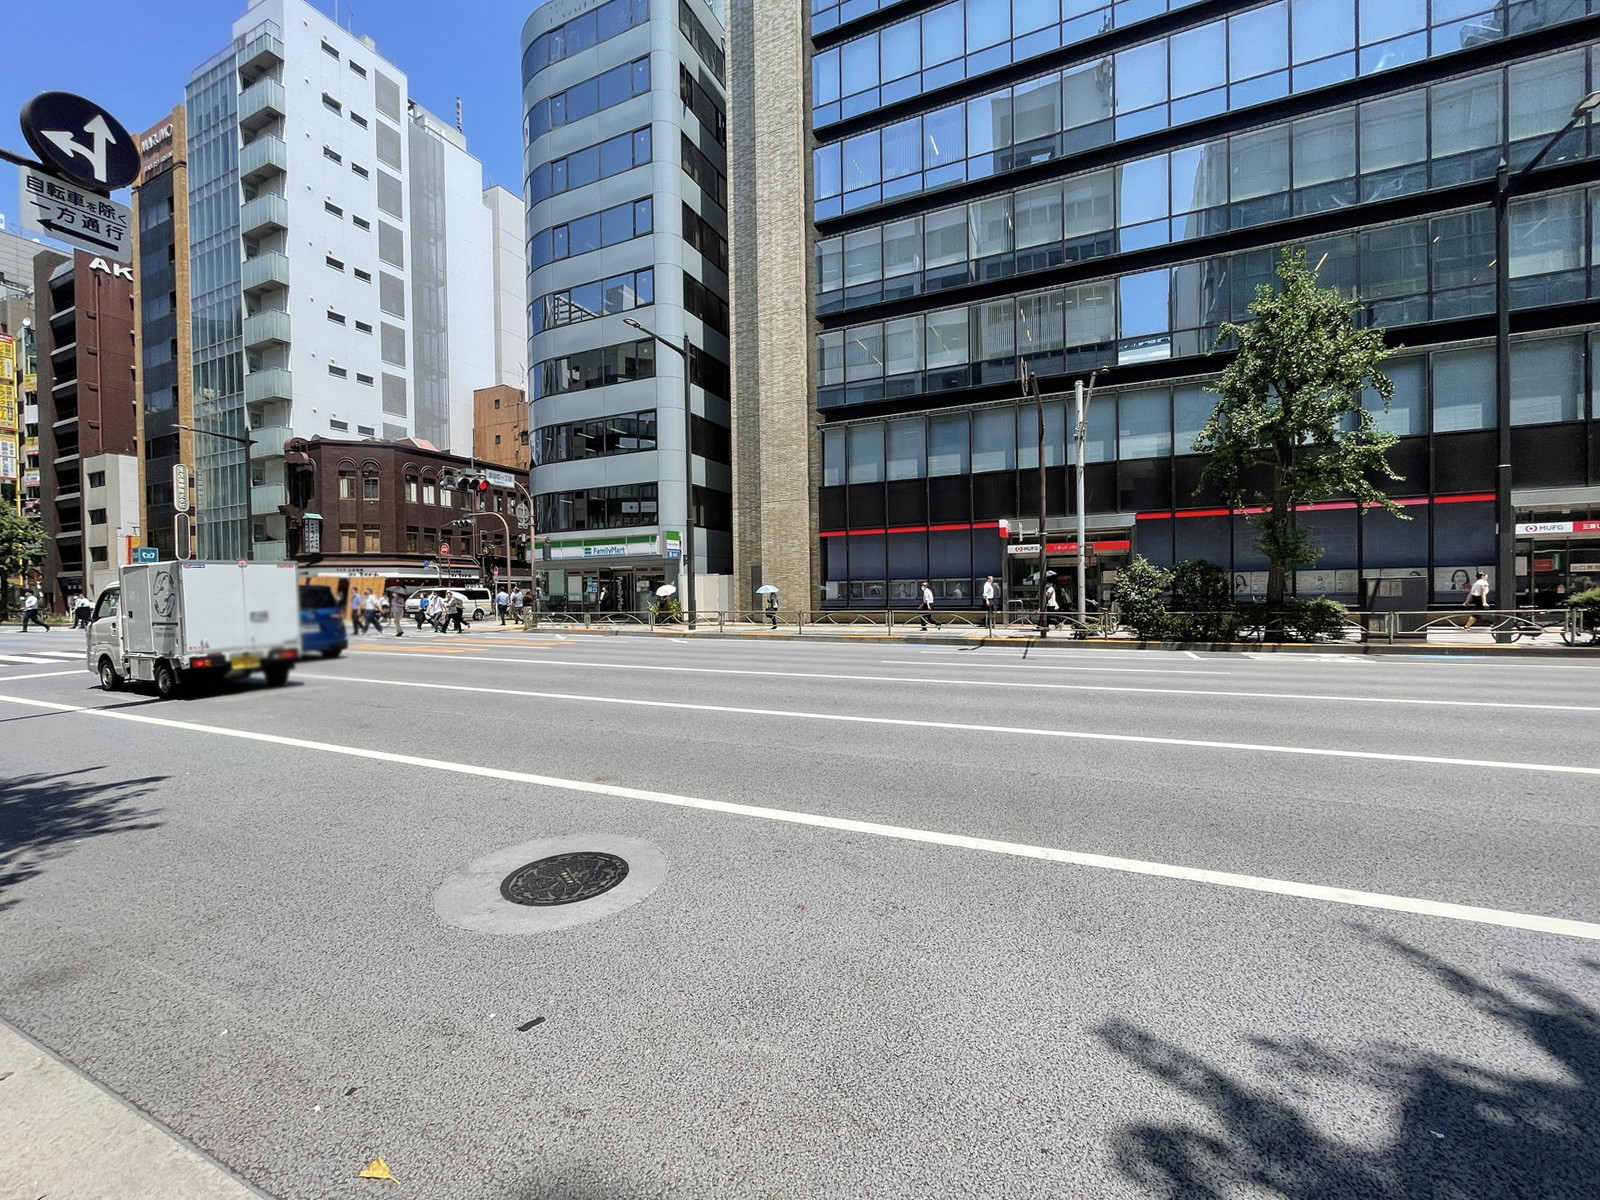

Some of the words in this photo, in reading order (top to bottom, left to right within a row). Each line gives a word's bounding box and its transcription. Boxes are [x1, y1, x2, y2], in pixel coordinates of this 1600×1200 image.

[26, 175, 127, 225] 自転車を除く
[30, 200, 124, 241] 一方通行
[593, 546, 625, 555] FamilyMart
